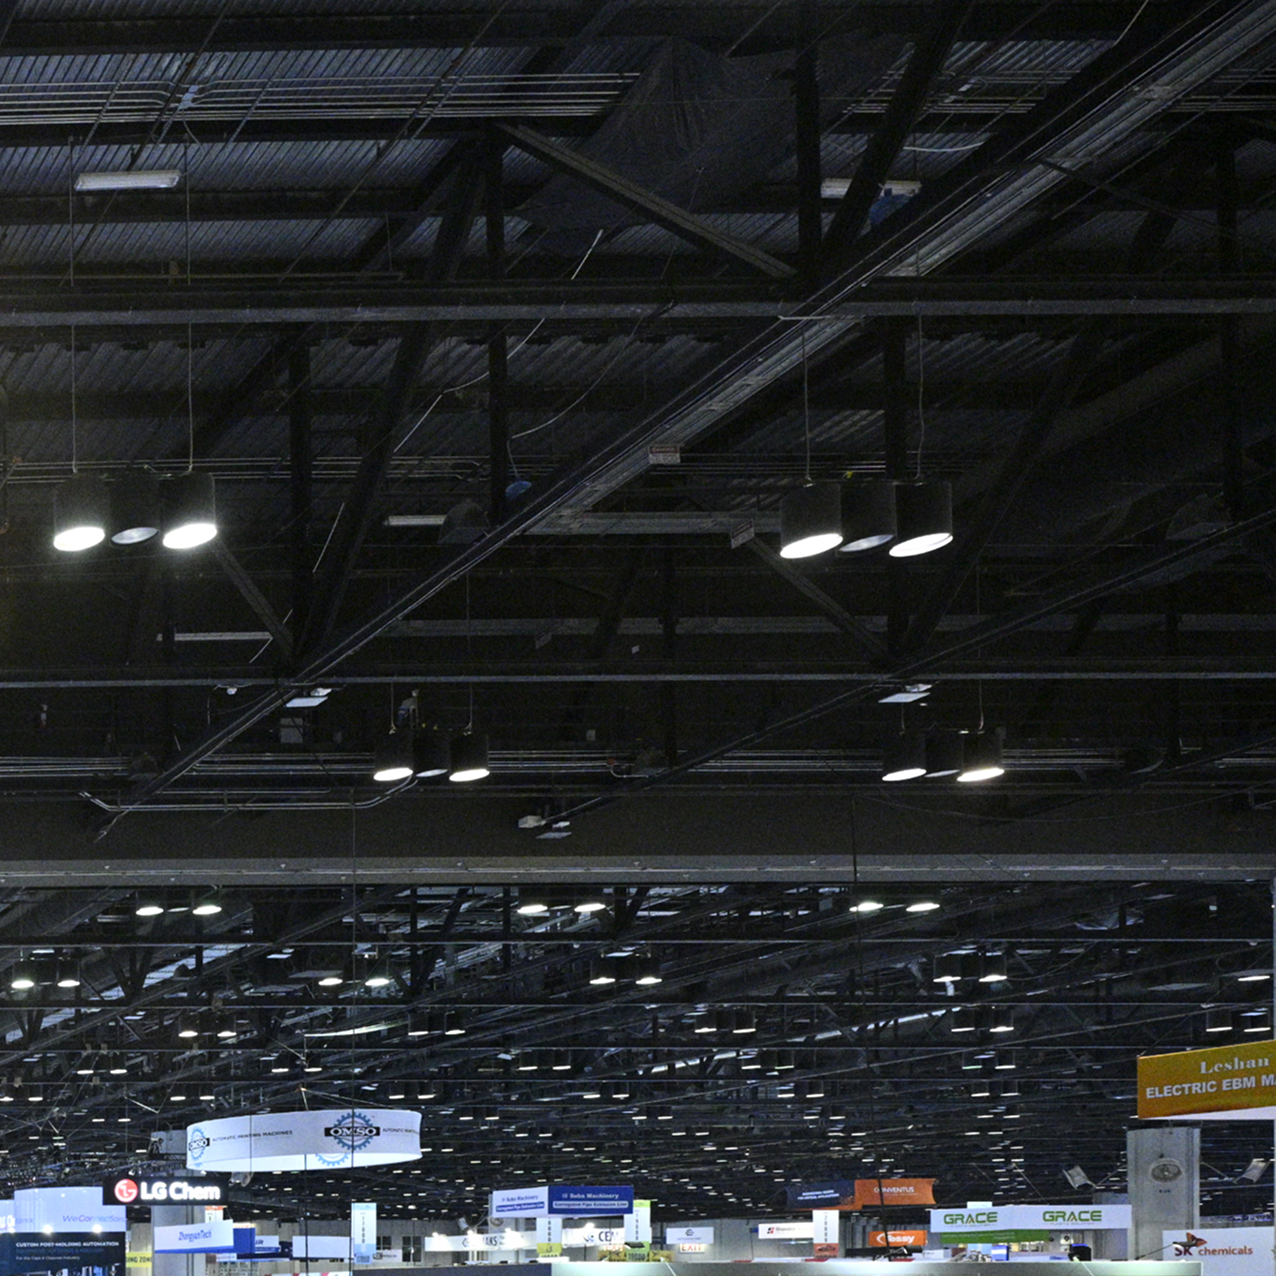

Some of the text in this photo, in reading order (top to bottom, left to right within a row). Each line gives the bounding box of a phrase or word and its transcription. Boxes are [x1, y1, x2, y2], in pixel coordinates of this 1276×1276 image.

[1200, 1057, 1270, 1074] Leshan
[1146, 1080, 1217, 1099] ELECTRIC
[1222, 1076, 1256, 1091] EBM
[140, 1181, 221, 1201] LG Chem
[943, 1211, 998, 1225] GRACE
[1042, 1210, 1102, 1222] GRACE
[680, 1243, 702, 1252] EXIT
[1198, 1245, 1254, 1256] chemicals
